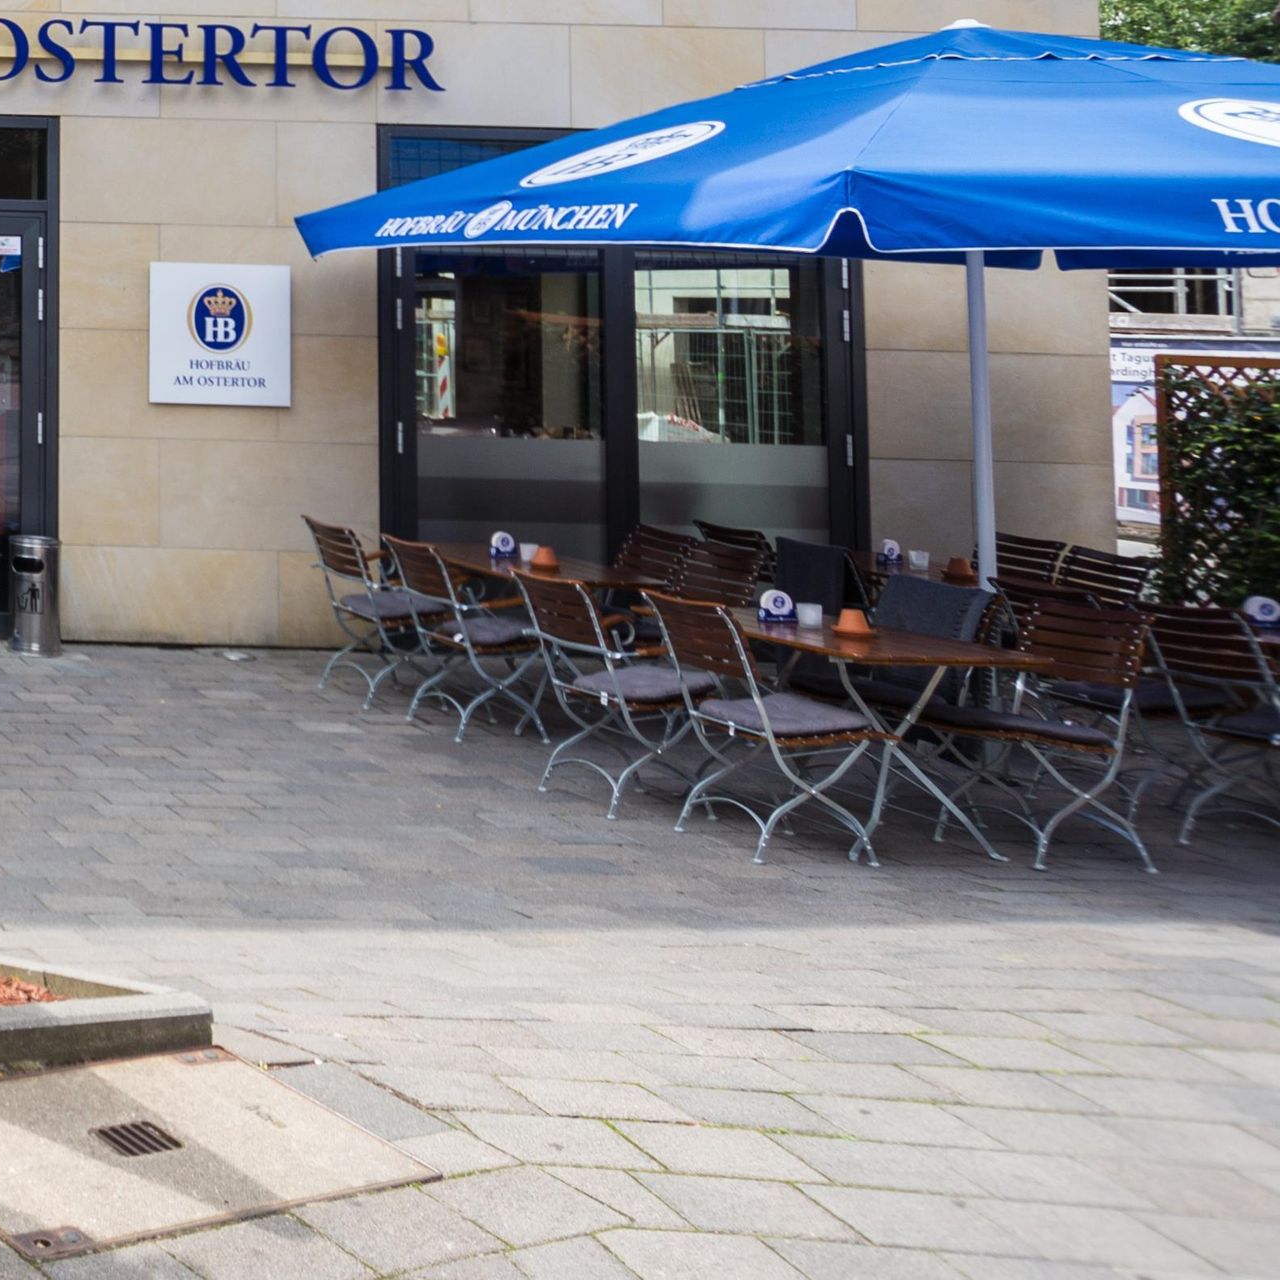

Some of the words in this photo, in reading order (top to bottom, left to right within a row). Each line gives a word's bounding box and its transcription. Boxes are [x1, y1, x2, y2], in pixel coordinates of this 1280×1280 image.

[374, 210, 476, 238] HOFBRÄU
[494, 203, 639, 232] MÜNCHEN
[204, 317, 237, 343] HB
[189, 358, 251, 372] HOFBRÄU
[173, 375, 194, 387] AM
[197, 375, 267, 389] OSTERTOR
